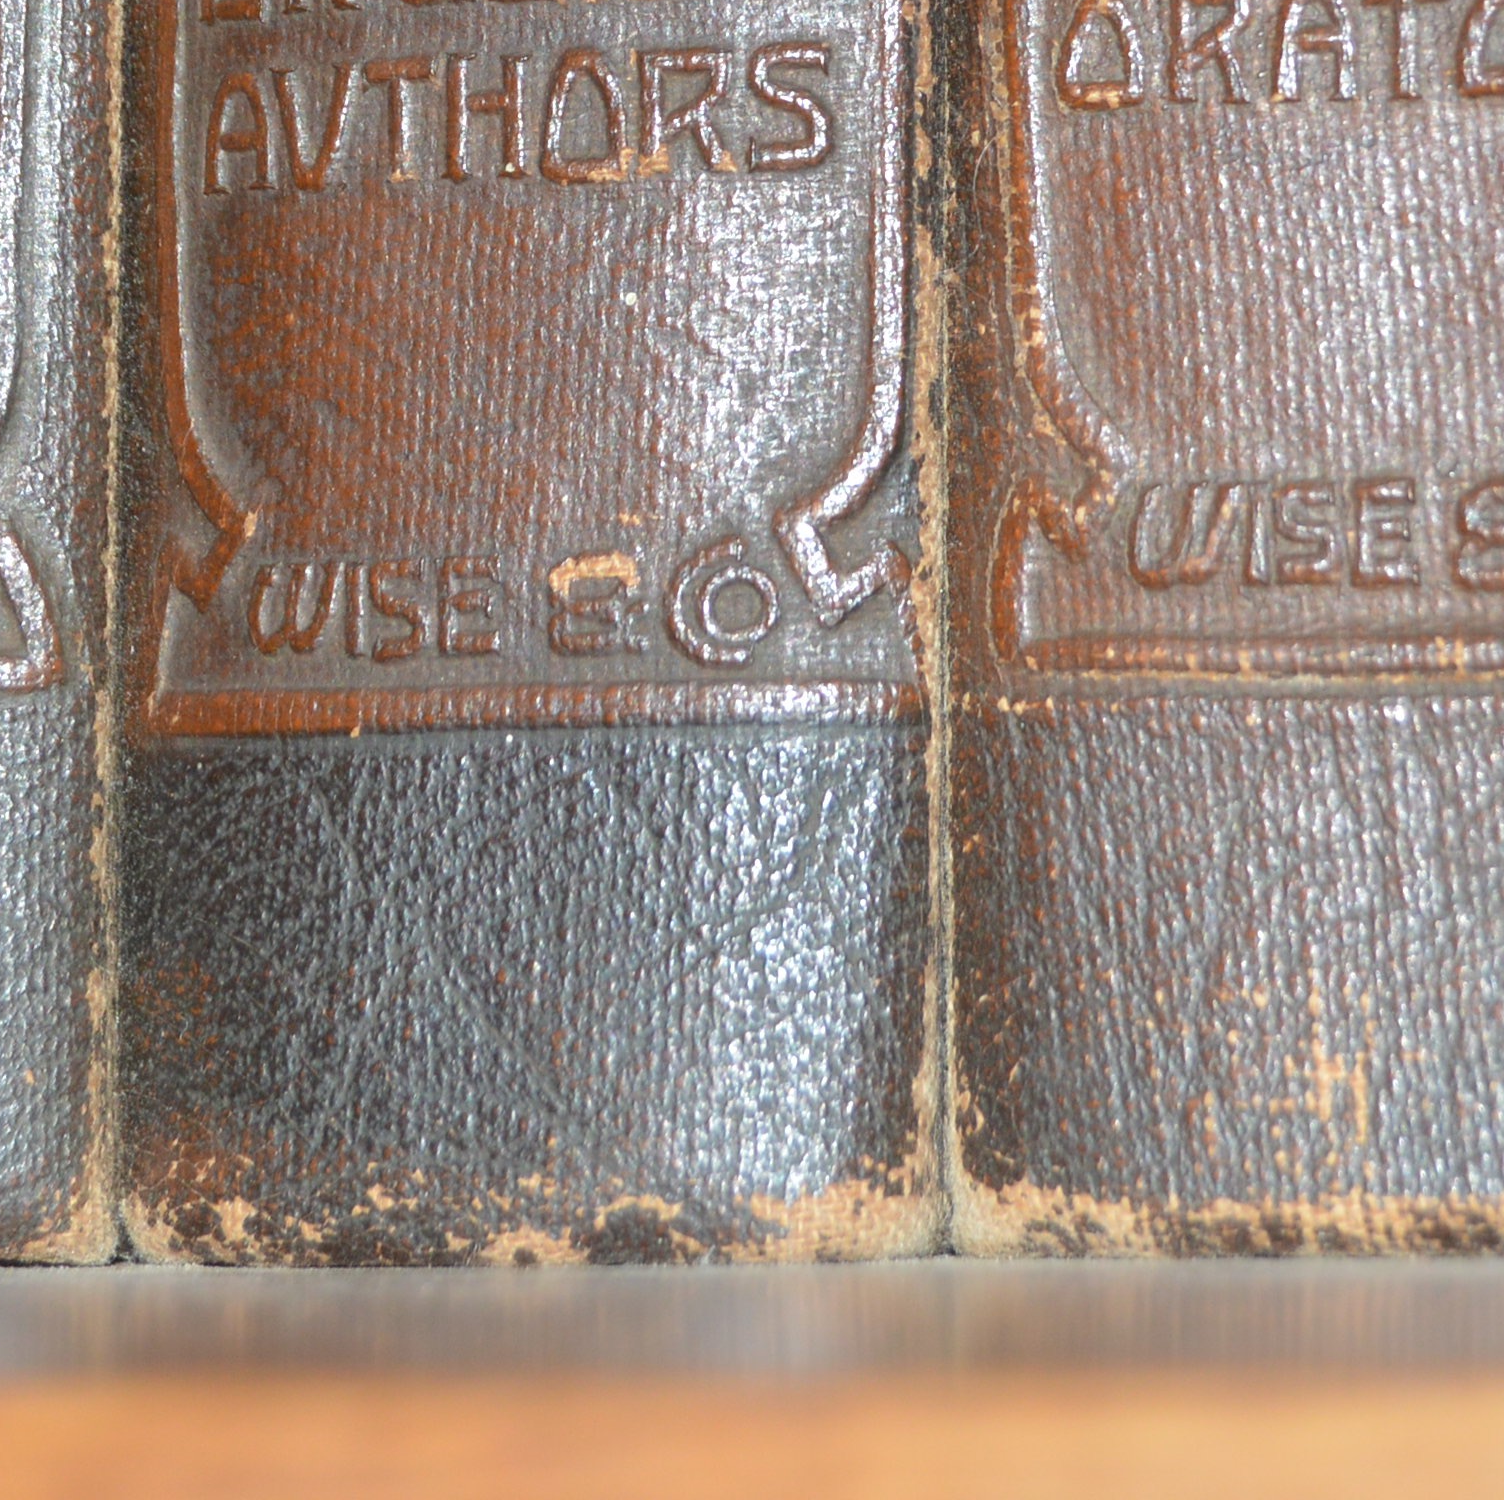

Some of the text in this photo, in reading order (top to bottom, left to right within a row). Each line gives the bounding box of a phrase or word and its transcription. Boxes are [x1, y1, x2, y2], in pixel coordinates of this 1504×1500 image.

[202, 41, 832, 195] AVTHORS
[1126, 477, 1421, 592] WISE
[246, 553, 502, 662] WISE
[546, 550, 650, 656] &
